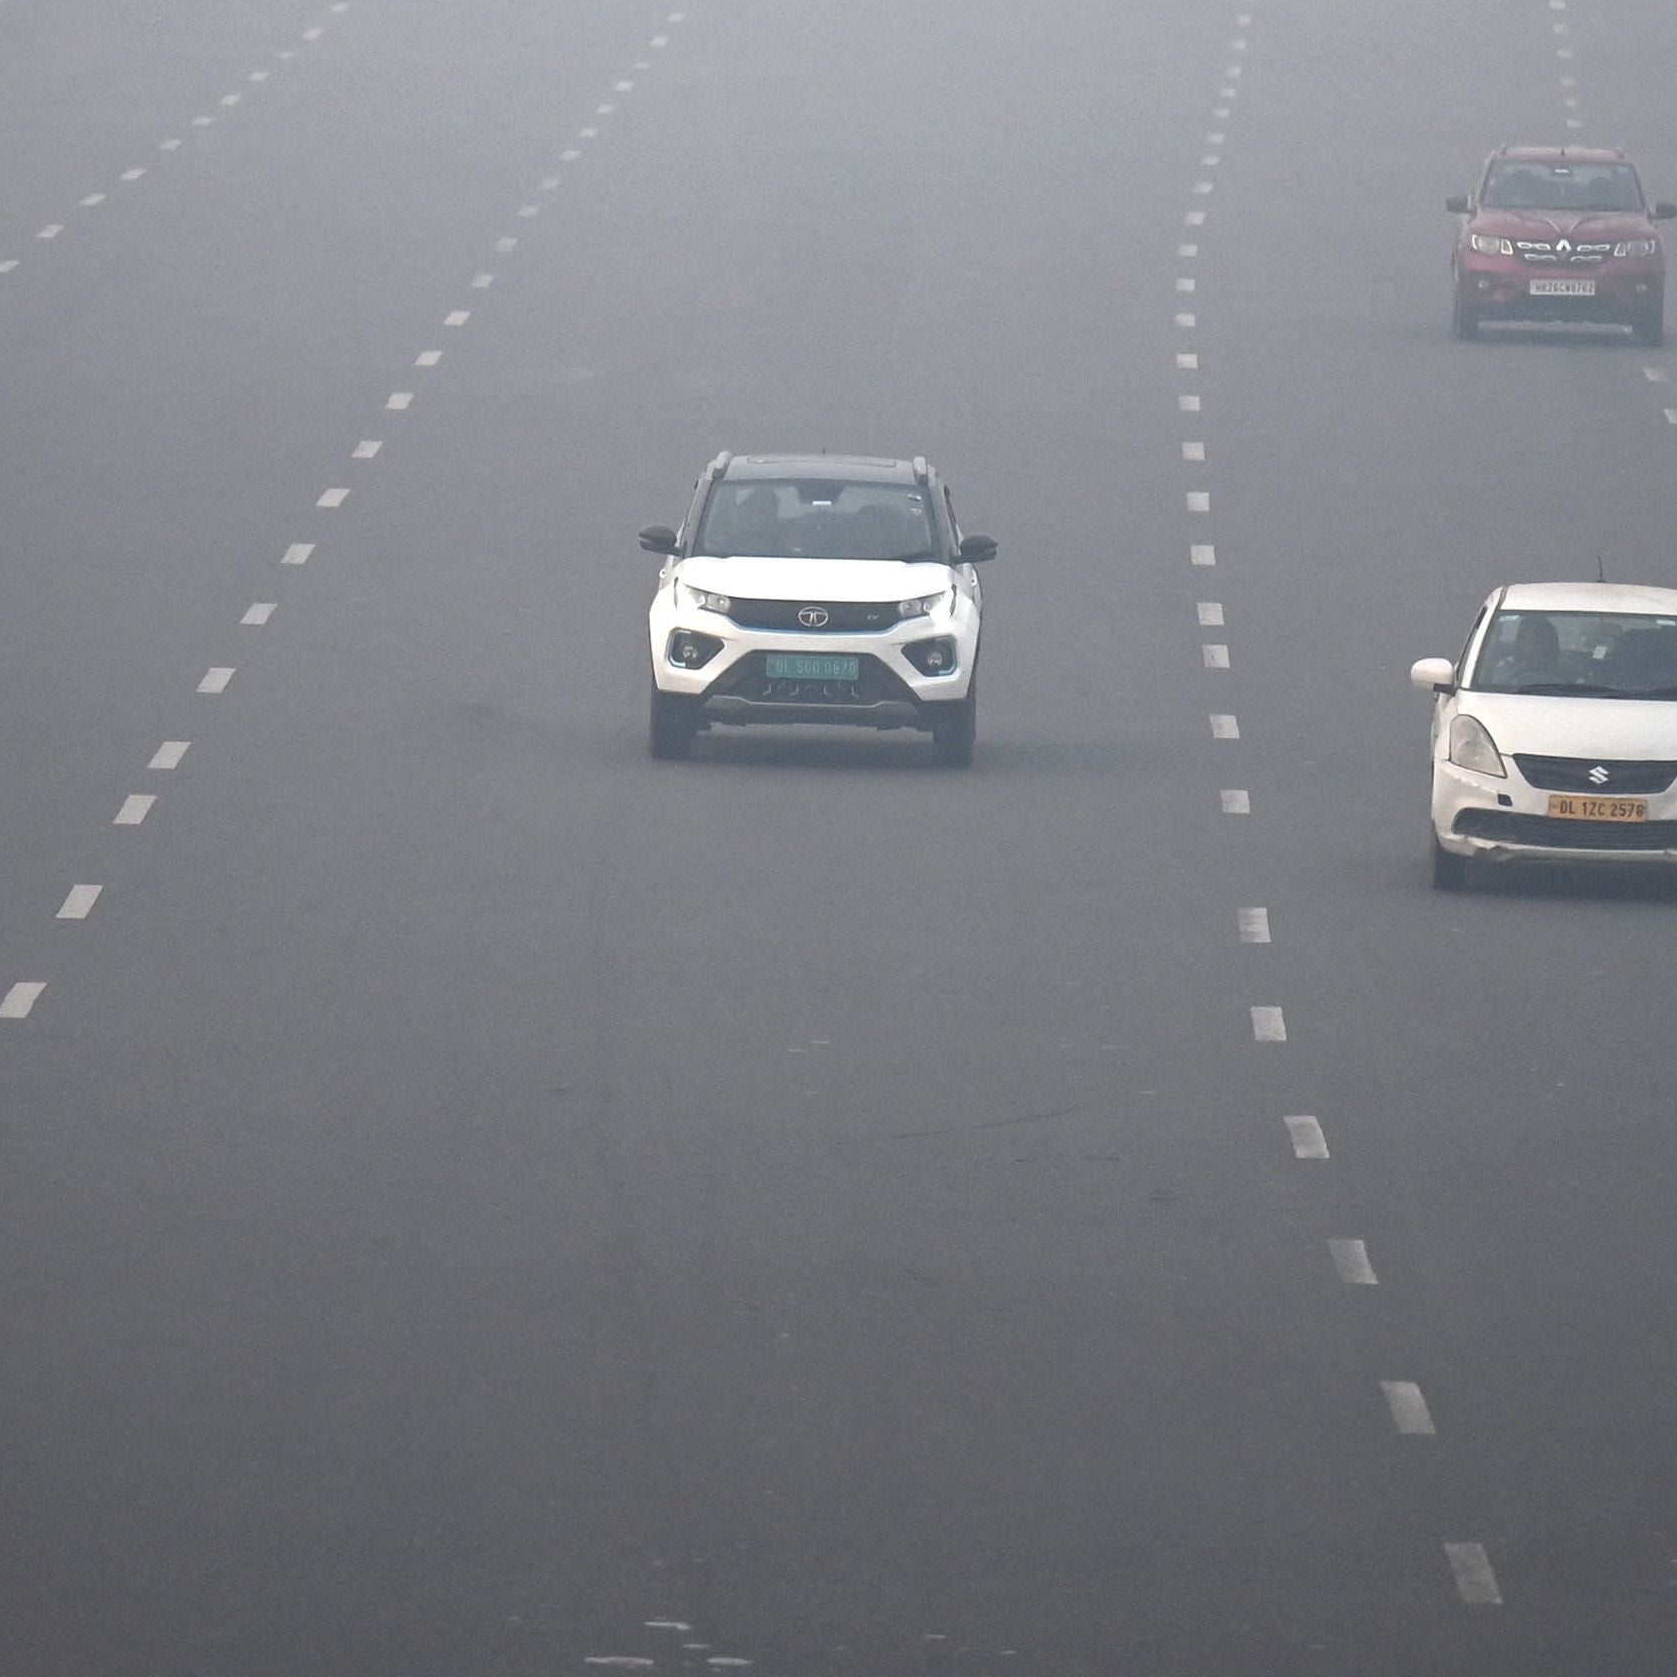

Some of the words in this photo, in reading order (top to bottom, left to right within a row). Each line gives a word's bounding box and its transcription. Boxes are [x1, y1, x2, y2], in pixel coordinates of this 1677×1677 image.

[1560, 800, 1576, 814] DL
[1582, 802, 1606, 816] 1ZC
[1610, 803, 1645, 818] 2578
